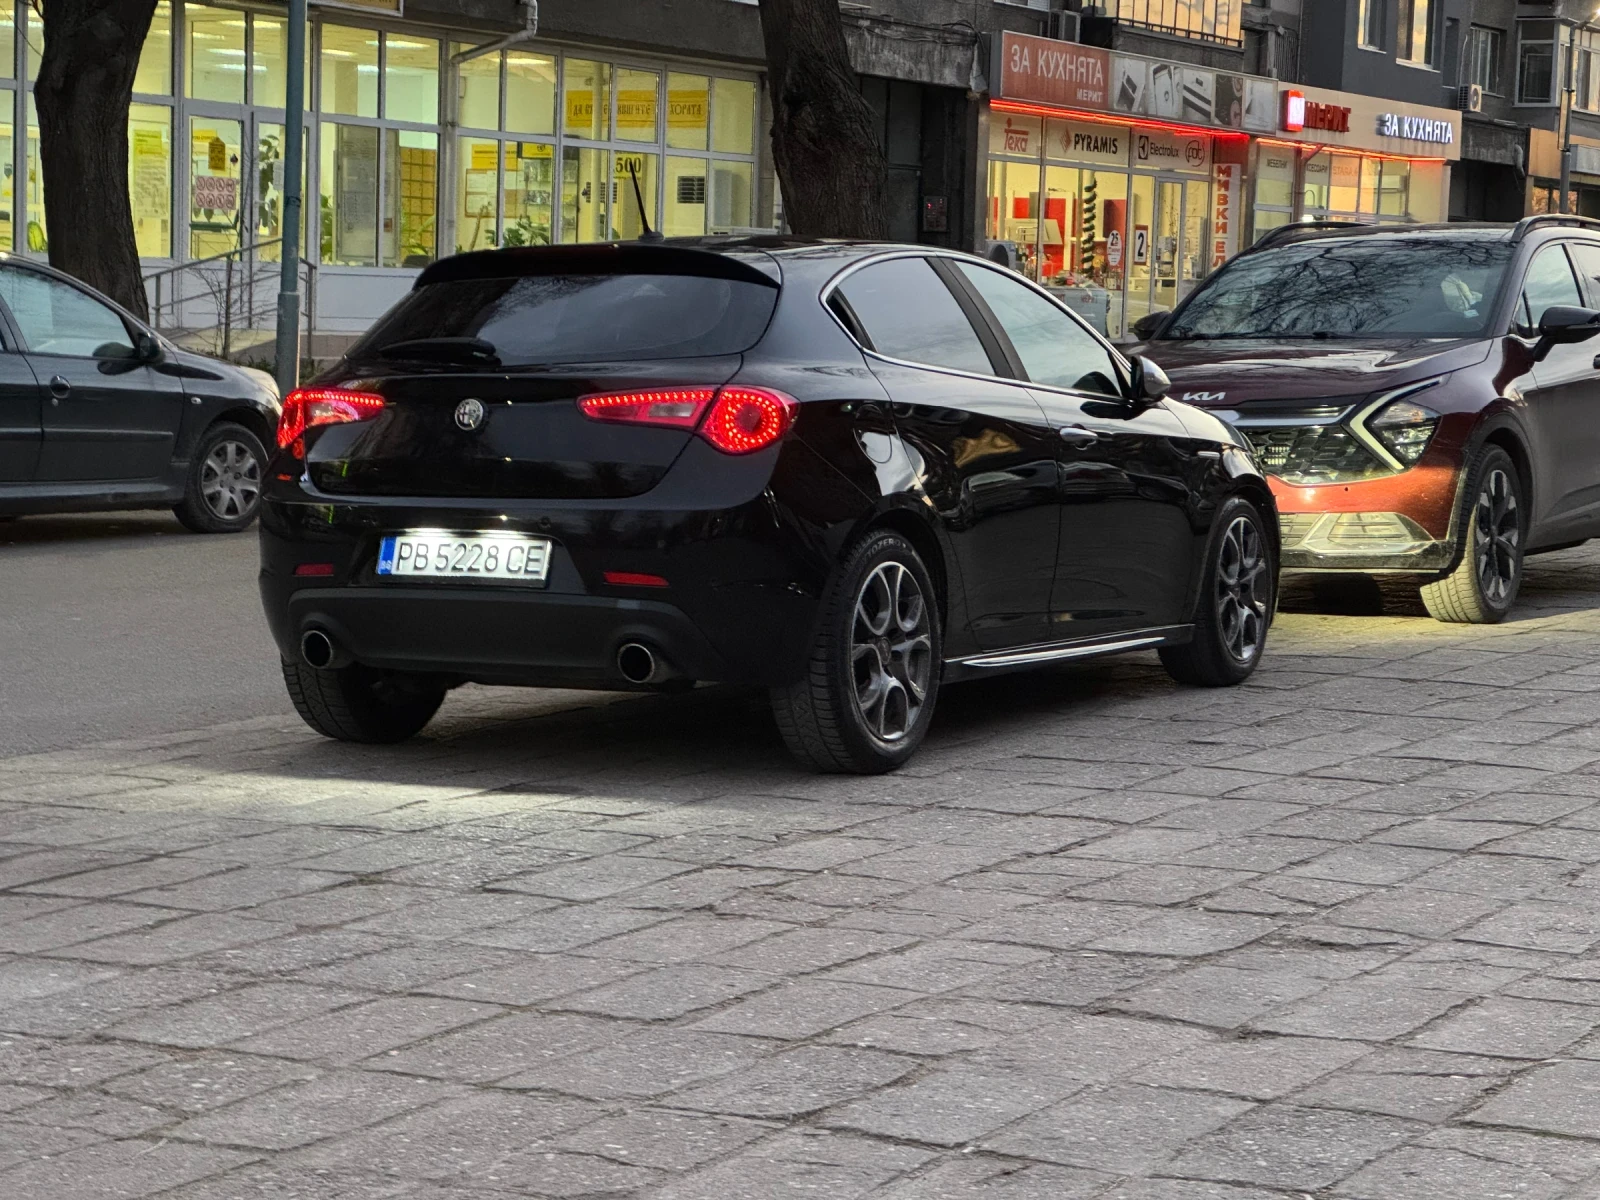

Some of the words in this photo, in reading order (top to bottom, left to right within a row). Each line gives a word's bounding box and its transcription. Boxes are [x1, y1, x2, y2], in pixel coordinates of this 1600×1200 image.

[1010, 44, 1031, 74] ЗА
[1038, 48, 1104, 86] КУХНЯТА
[1076, 88, 1103, 103] МЕРИТ
[669, 104, 702, 115] ХОРАТА
[1305, 101, 1351, 132] МЕРИТ
[1384, 113, 1399, 136] ЗА
[1404, 116, 1453, 143] КУХНЯТА
[1073, 133, 1118, 154] PYRAMIS
[1150, 142, 1180, 158] Electrolux
[1215, 165, 1232, 234] МИВКИ
[1137, 232, 1145, 257] 2
[1182, 392, 1226, 401] KIA
[397, 542, 429, 571] PB
[434, 542, 500, 572] 5228
[505, 545, 545, 574] CE
